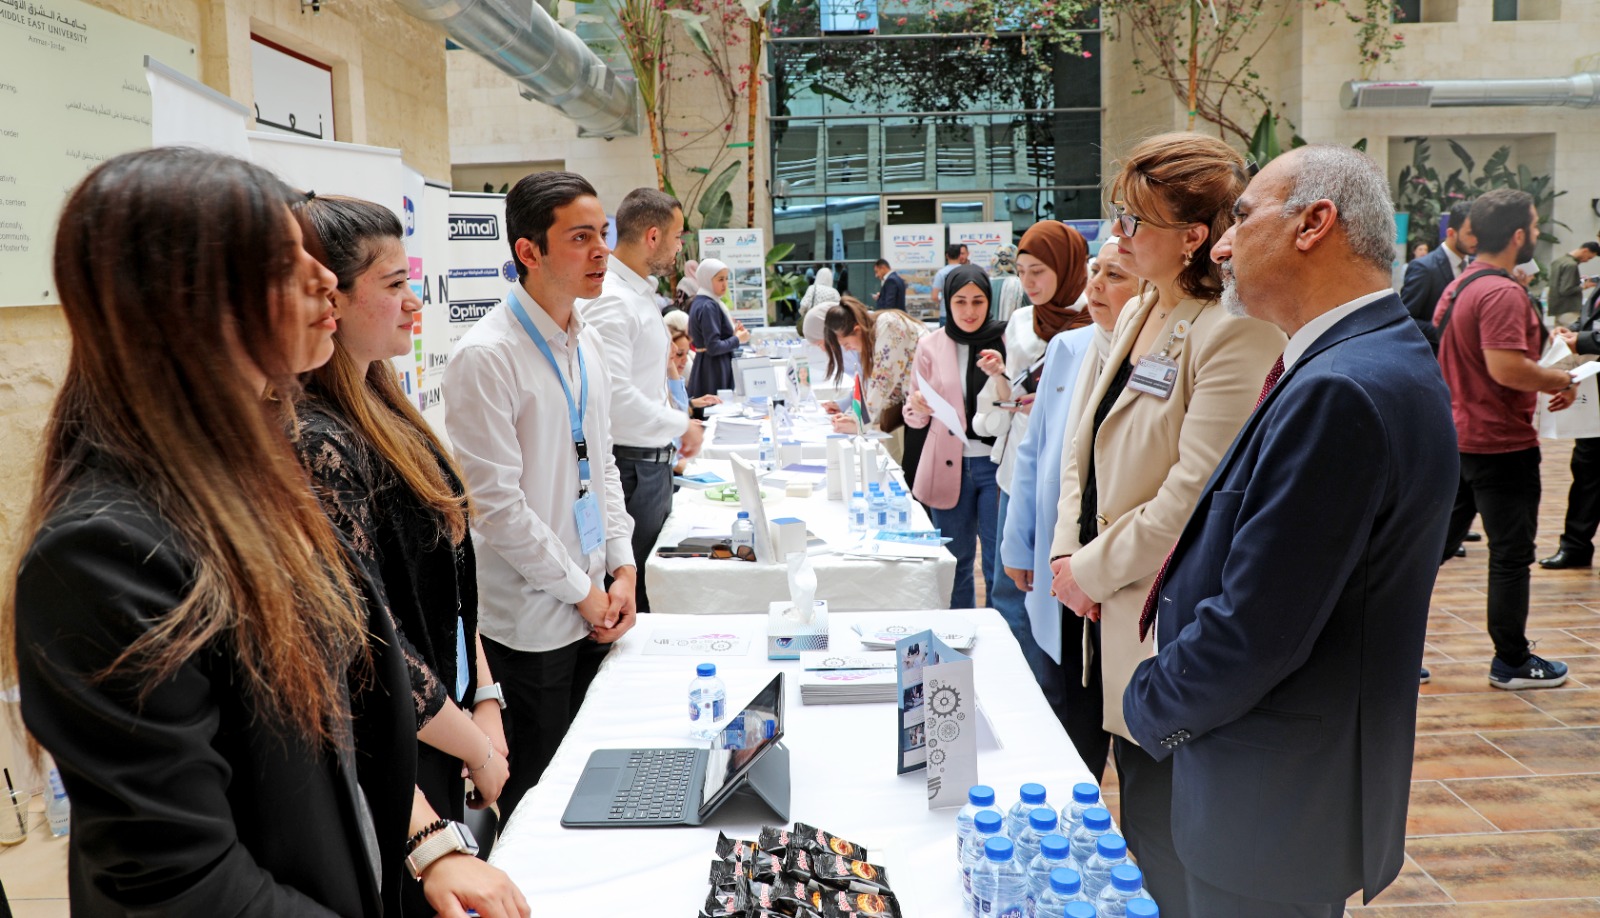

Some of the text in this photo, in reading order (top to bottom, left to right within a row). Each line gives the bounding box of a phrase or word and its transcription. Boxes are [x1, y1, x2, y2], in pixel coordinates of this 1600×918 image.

[28, 3, 55, 19] الشرق
[27, 18, 46, 31] EAST
[48, 24, 88, 44] UNIVERSITY
[57, 12, 87, 31] جامعة
